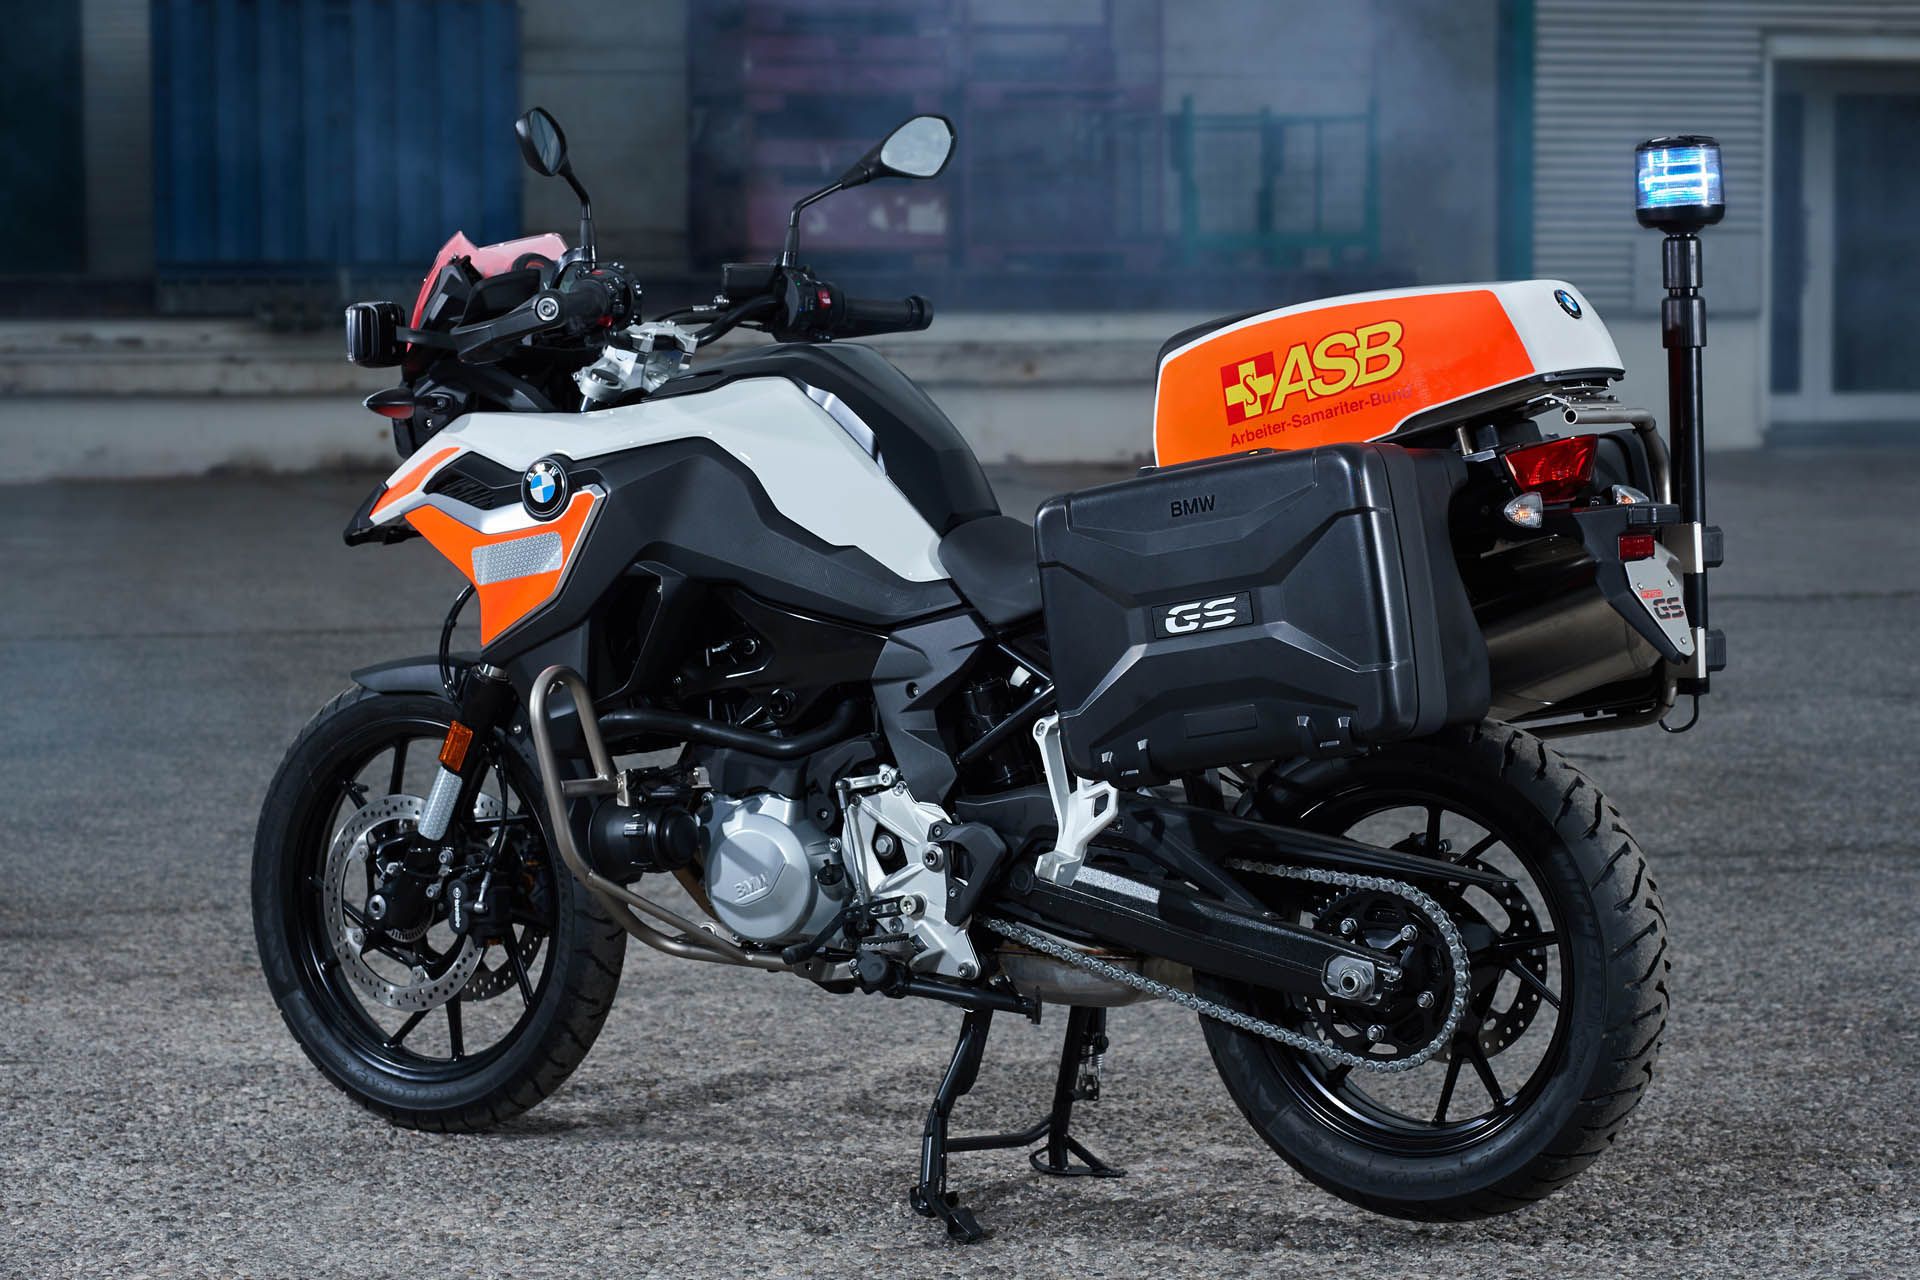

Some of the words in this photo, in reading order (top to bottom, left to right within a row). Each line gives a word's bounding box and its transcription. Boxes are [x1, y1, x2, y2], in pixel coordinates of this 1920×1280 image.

[1268, 320, 1404, 414] ASB
[526, 463, 560, 482] BMW
[1171, 496, 1216, 517] BMW
[1165, 597, 1237, 633] GS
[1653, 597, 1684, 619] GS
[734, 873, 768, 898] BMW
